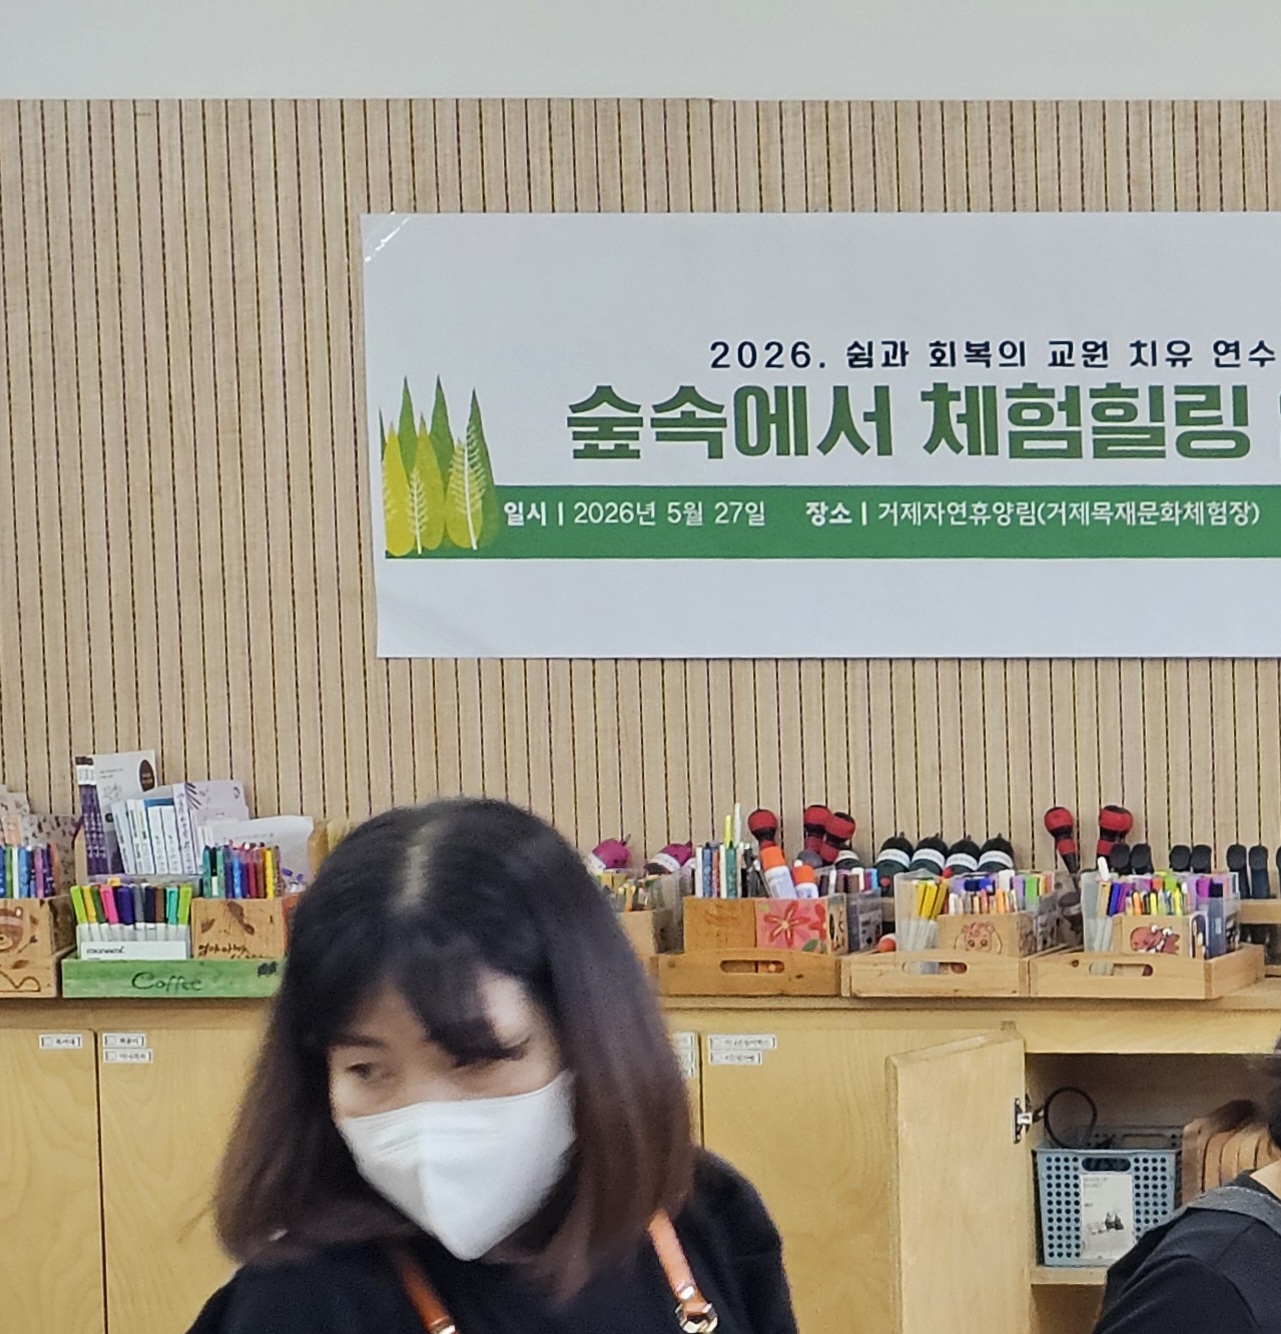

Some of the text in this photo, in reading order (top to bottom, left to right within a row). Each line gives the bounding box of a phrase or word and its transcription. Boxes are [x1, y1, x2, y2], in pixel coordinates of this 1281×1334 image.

[710, 339, 1276, 369] 2026. 쉼과 회복의 교원 치유 연수
[566, 383, 893, 460] 숲속에서
[920, 381, 1251, 460] 체험힐링
[503, 501, 547, 527] 일시
[574, 501, 656, 526] 2026년
[667, 501, 703, 526] 5월
[714, 501, 765, 526] 27일
[806, 501, 853, 527] 장소
[878, 500, 1260, 528] 거제자연휴양림(거제목재문화체험장)
[131, 971, 203, 993] Coffee
